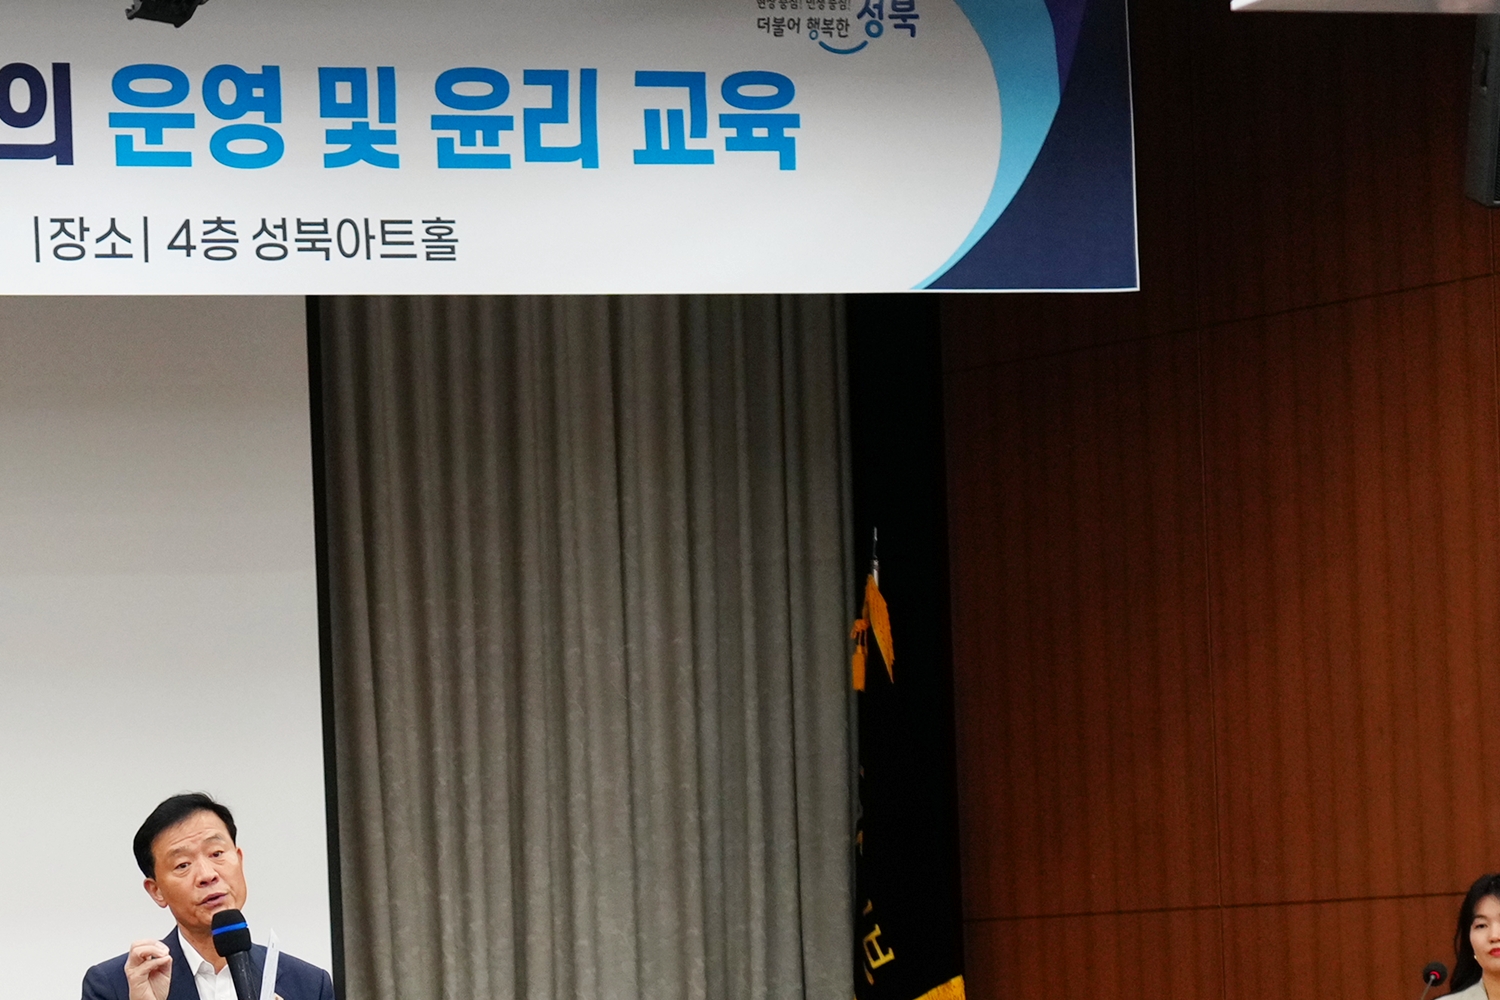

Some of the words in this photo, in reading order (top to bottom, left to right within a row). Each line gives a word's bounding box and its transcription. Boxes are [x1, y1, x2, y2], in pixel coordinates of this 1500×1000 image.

[756, 16, 801, 37] 더불어
[806, 16, 851, 40] 행복한
[856, 0, 920, 38] 성북
[107, 63, 286, 170] 운영
[317, 65, 401, 170] 및
[429, 66, 600, 170] 윤리
[632, 69, 803, 172] 교육
[166, 215, 240, 262] 4층
[252, 216, 460, 262] 성북아트홀
